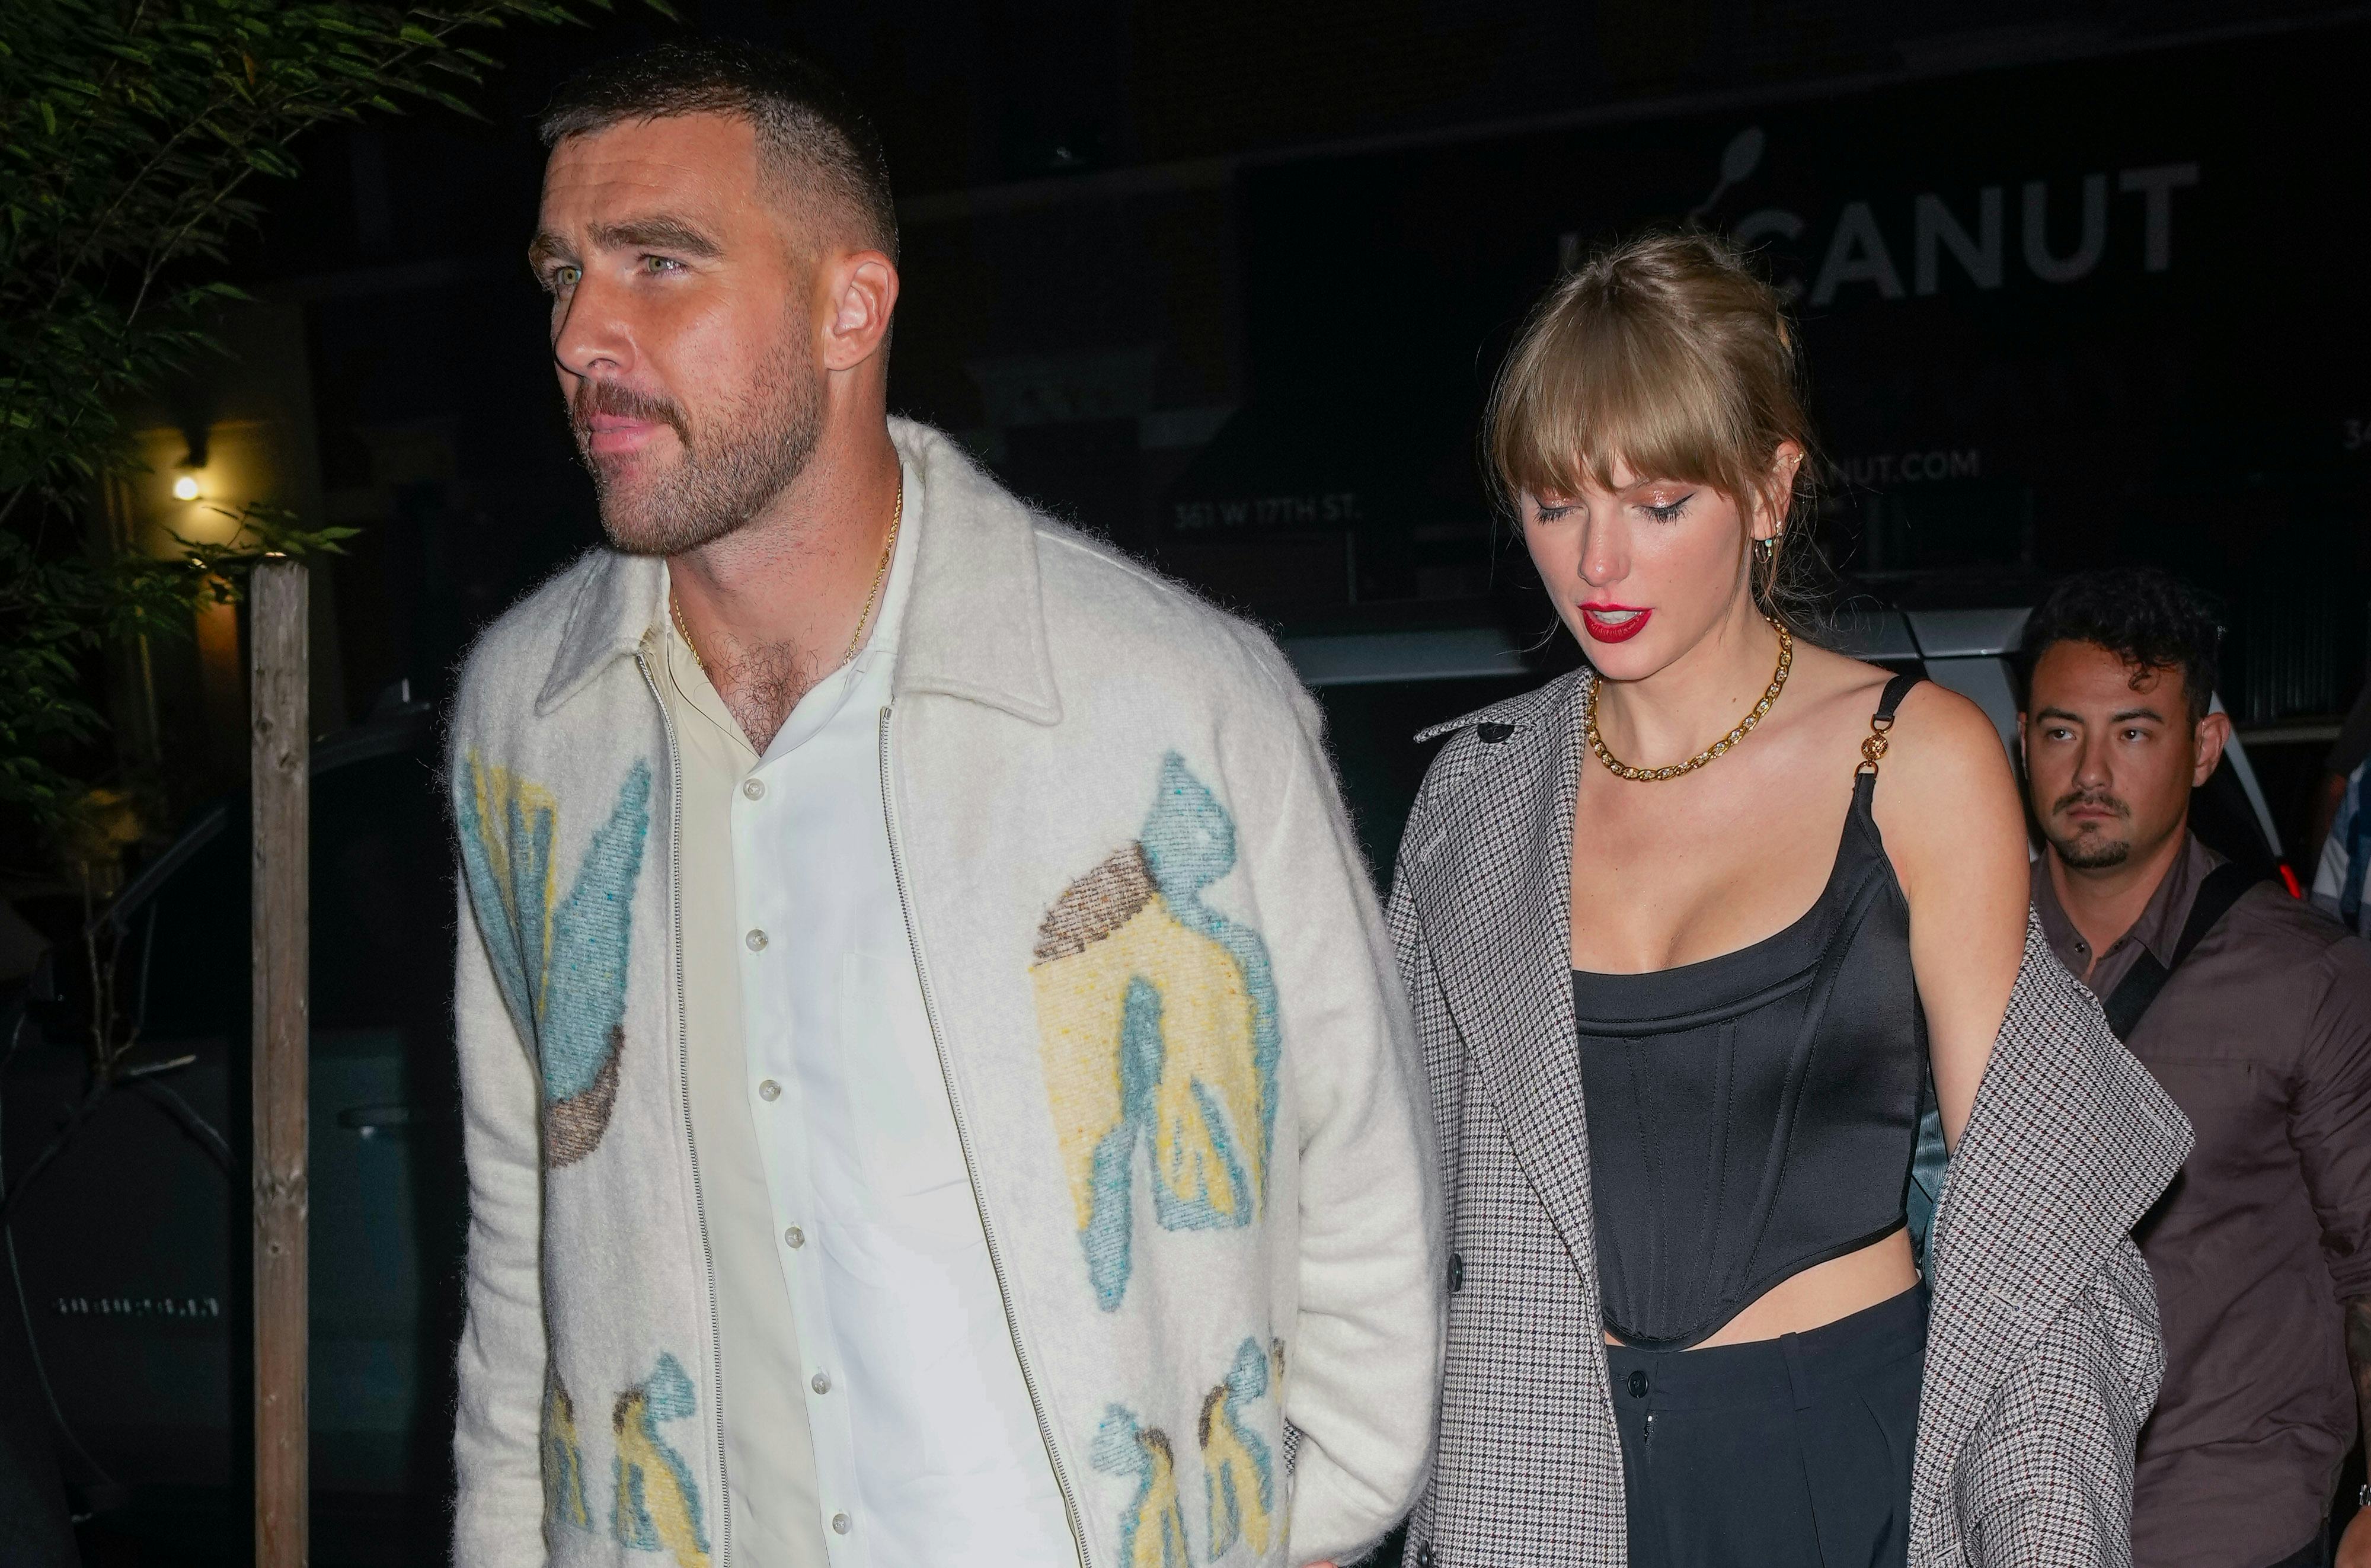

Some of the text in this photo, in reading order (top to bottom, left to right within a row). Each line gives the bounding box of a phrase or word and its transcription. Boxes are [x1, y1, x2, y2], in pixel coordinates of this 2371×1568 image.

[1559, 163, 2199, 306] CANUT
[1219, 500, 1249, 526] W
[1254, 494, 1316, 525] 17TH
[1322, 492, 1363, 521] ST.
